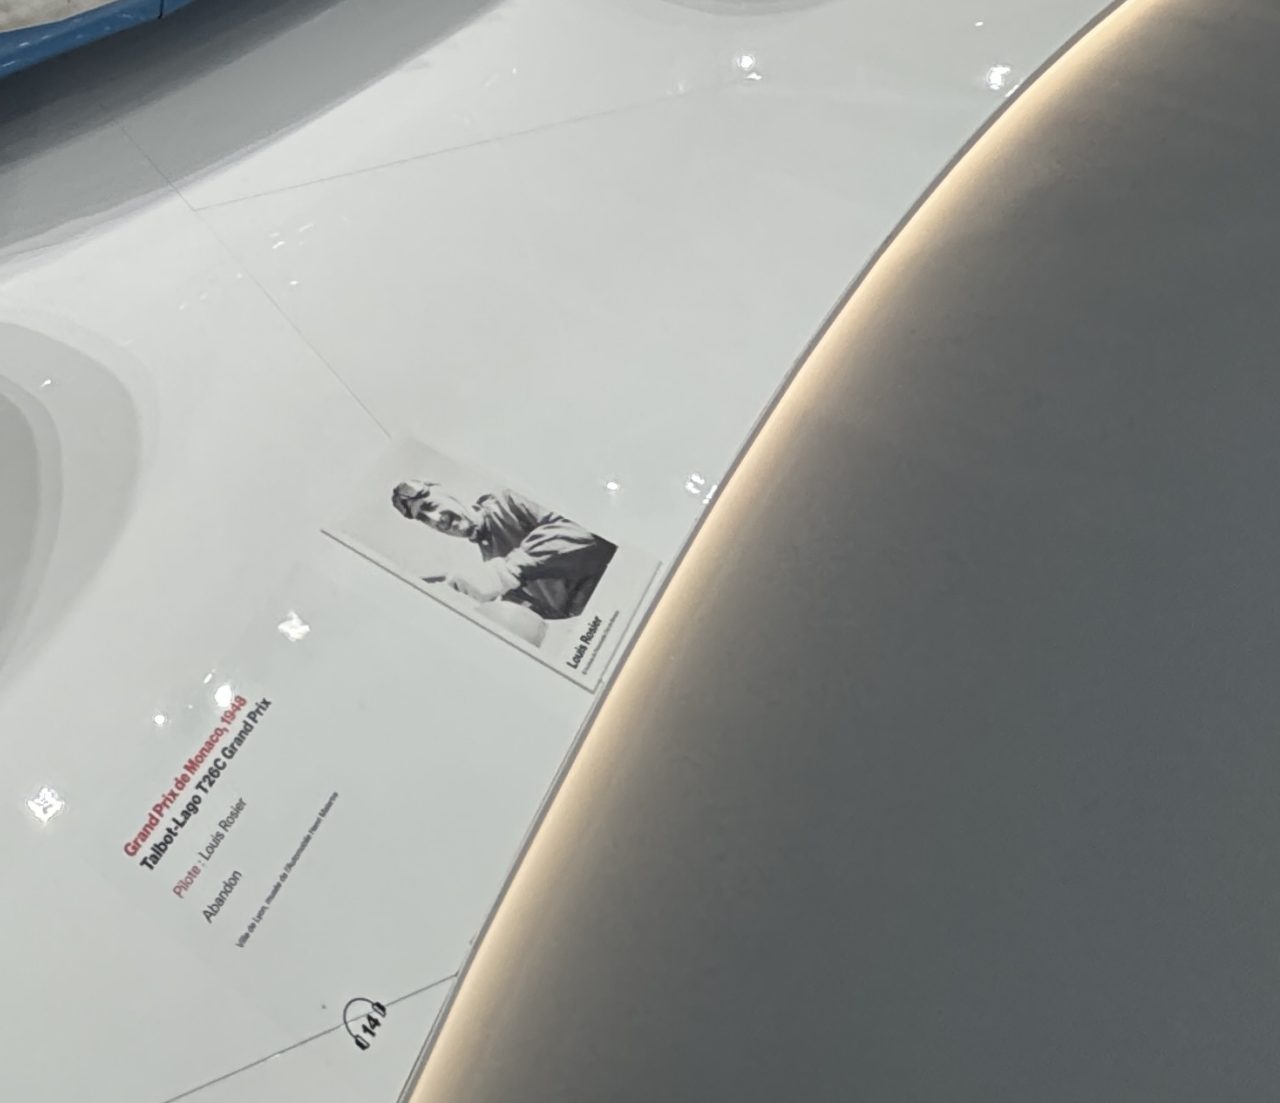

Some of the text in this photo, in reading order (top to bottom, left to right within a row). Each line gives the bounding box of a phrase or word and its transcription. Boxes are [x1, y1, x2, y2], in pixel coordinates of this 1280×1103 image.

[566, 643, 588, 669] Louis
[580, 616, 603, 645] Rosier
[123, 695, 247, 858] Grand Prix de Monaco, 1948
[138, 697, 273, 872] Talbot-Lago T26C Grand Prix
[172, 864, 202, 899] Pilote
[197, 830, 226, 862] Louis
[218, 797, 247, 833] Rosier
[202, 869, 242, 924] Abandon
[362, 1013, 381, 1037] 14
